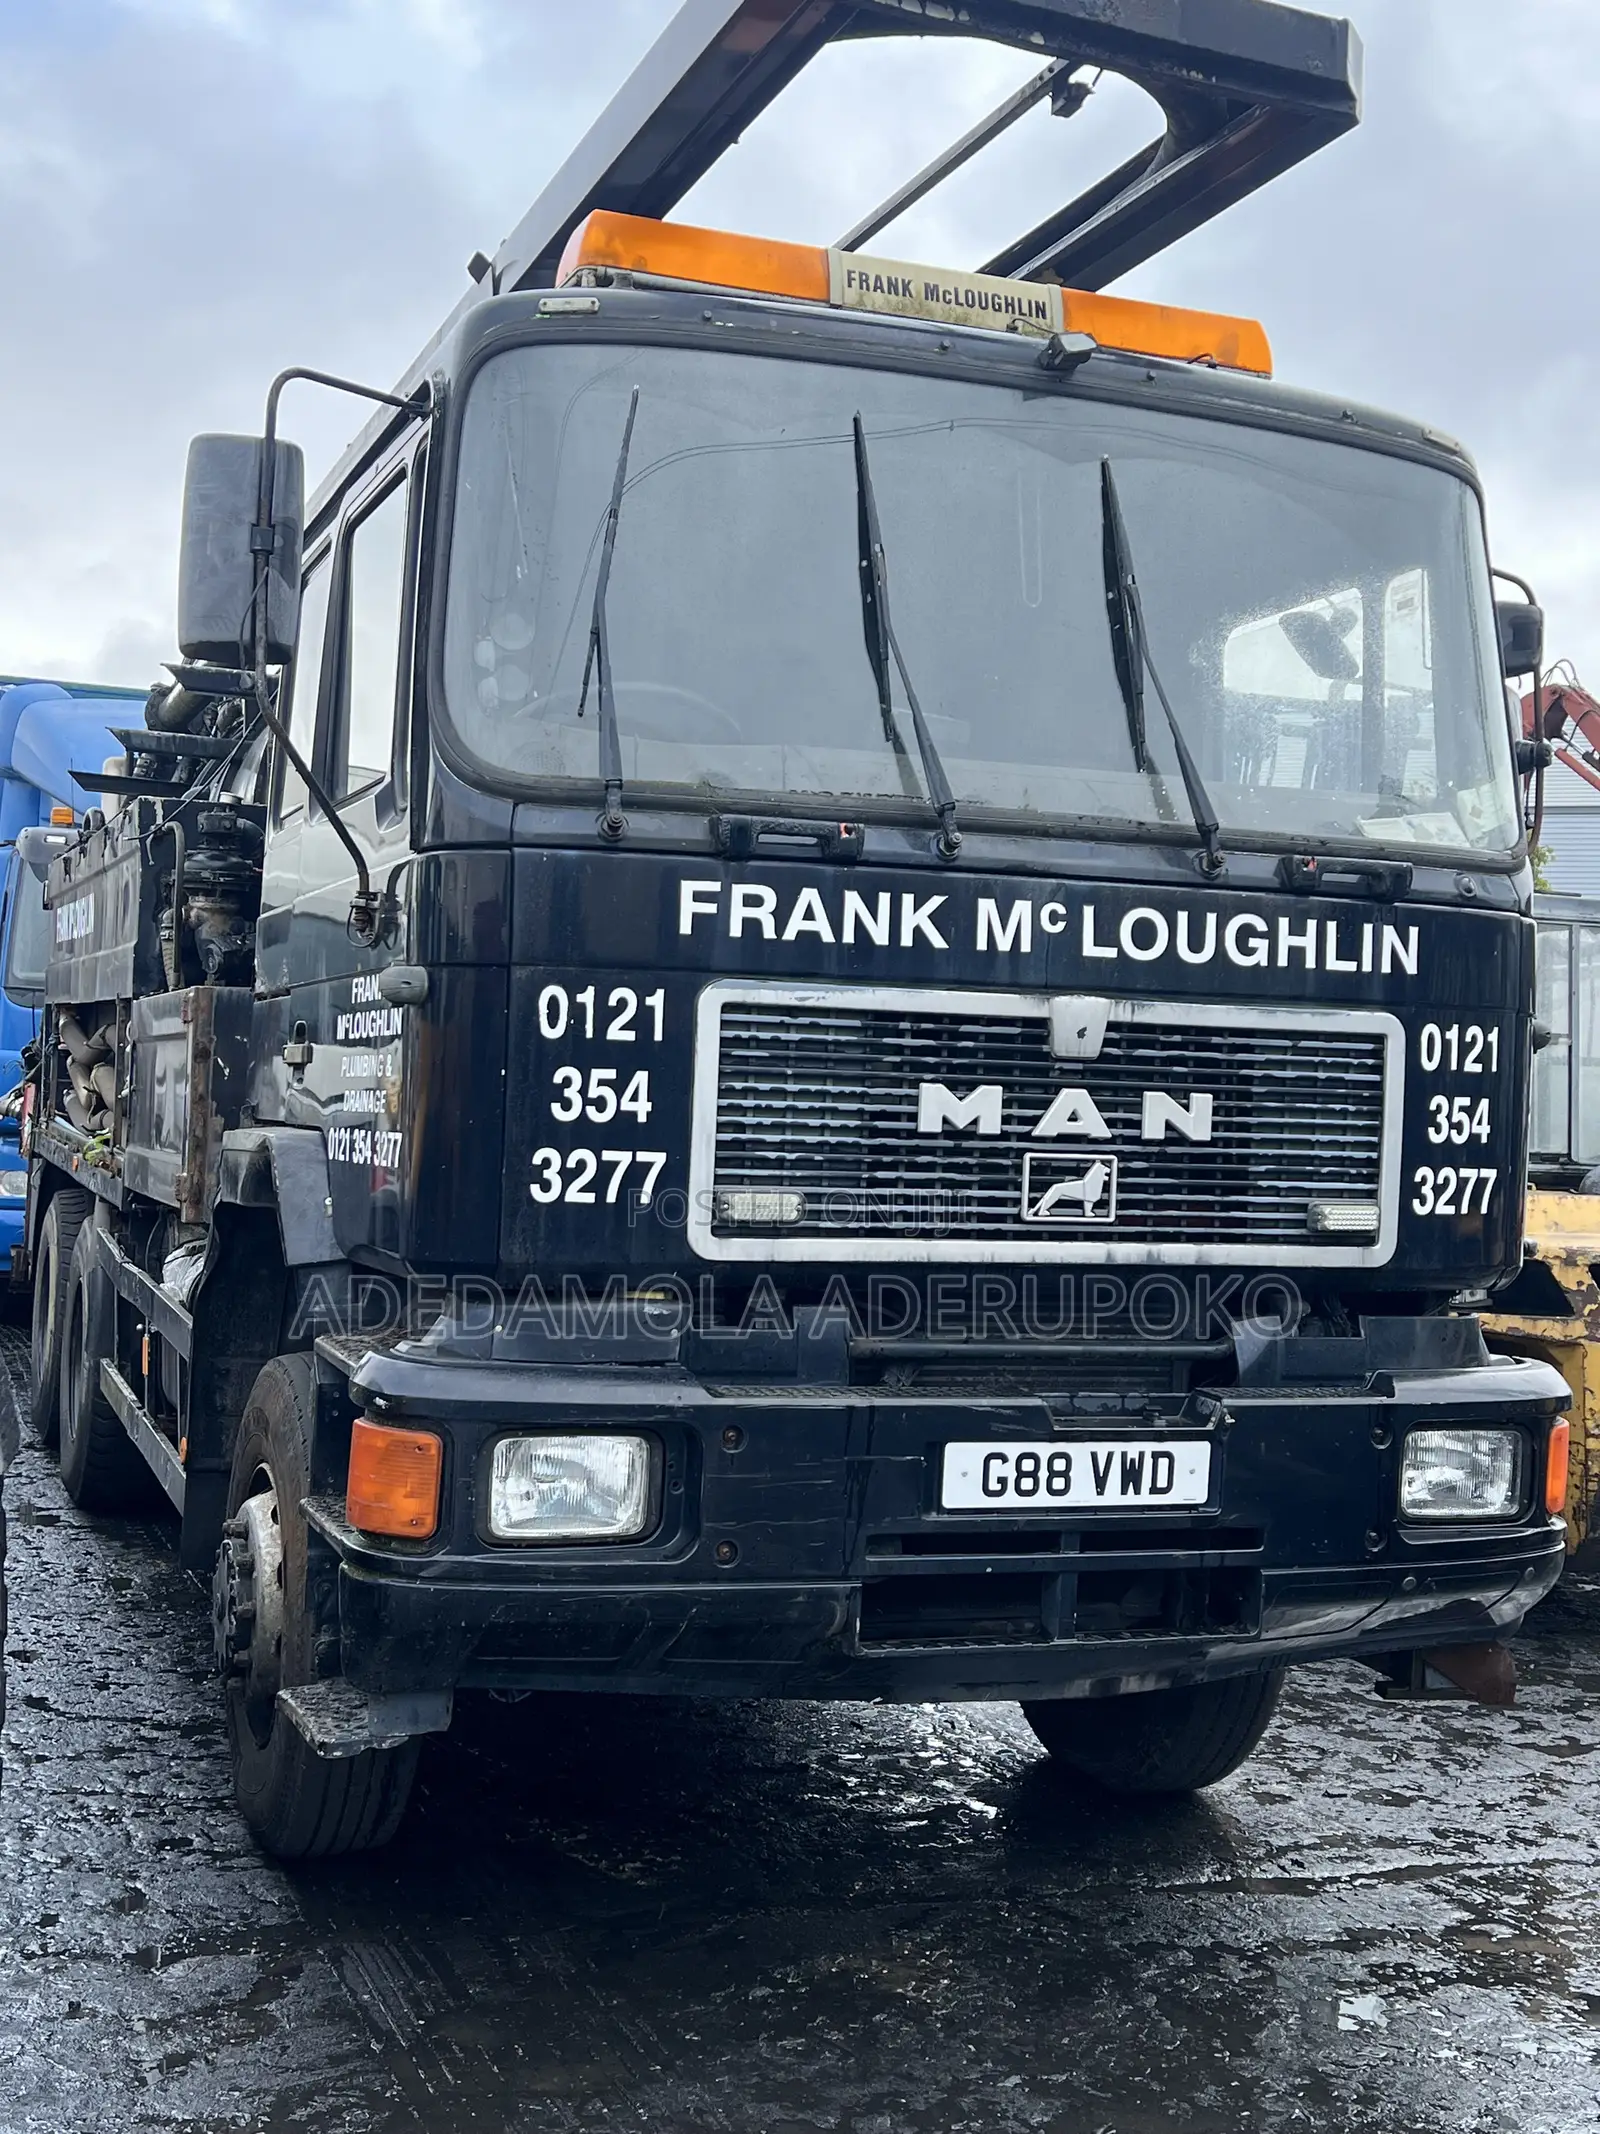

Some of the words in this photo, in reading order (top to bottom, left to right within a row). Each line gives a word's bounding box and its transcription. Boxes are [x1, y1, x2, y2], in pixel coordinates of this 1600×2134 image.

[846, 268, 913, 299] FRANK
[923, 281, 1047, 320] McLOUGHLIN
[677, 879, 949, 950] FRANK
[351, 973, 382, 1005] FRAN
[537, 985, 666, 1042] 0121
[340, 1053, 385, 1079] PLUMBING
[385, 1053, 393, 1077] &
[1420, 1022, 1500, 1073] 0121
[343, 1090, 387, 1114] DRAINAGE
[550, 1065, 653, 1123] 354
[917, 1082, 1214, 1141] MAN
[1427, 1094, 1491, 1145] 354
[327, 1127, 350, 1163] 0121
[351, 1128, 372, 1165] 354
[373, 1131, 403, 1168] 3277
[529, 1147, 667, 1204] 3277
[1412, 1165, 1498, 1216] 3277
[981, 1451, 1072, 1498] G88
[1090, 1450, 1176, 1496] VWD
